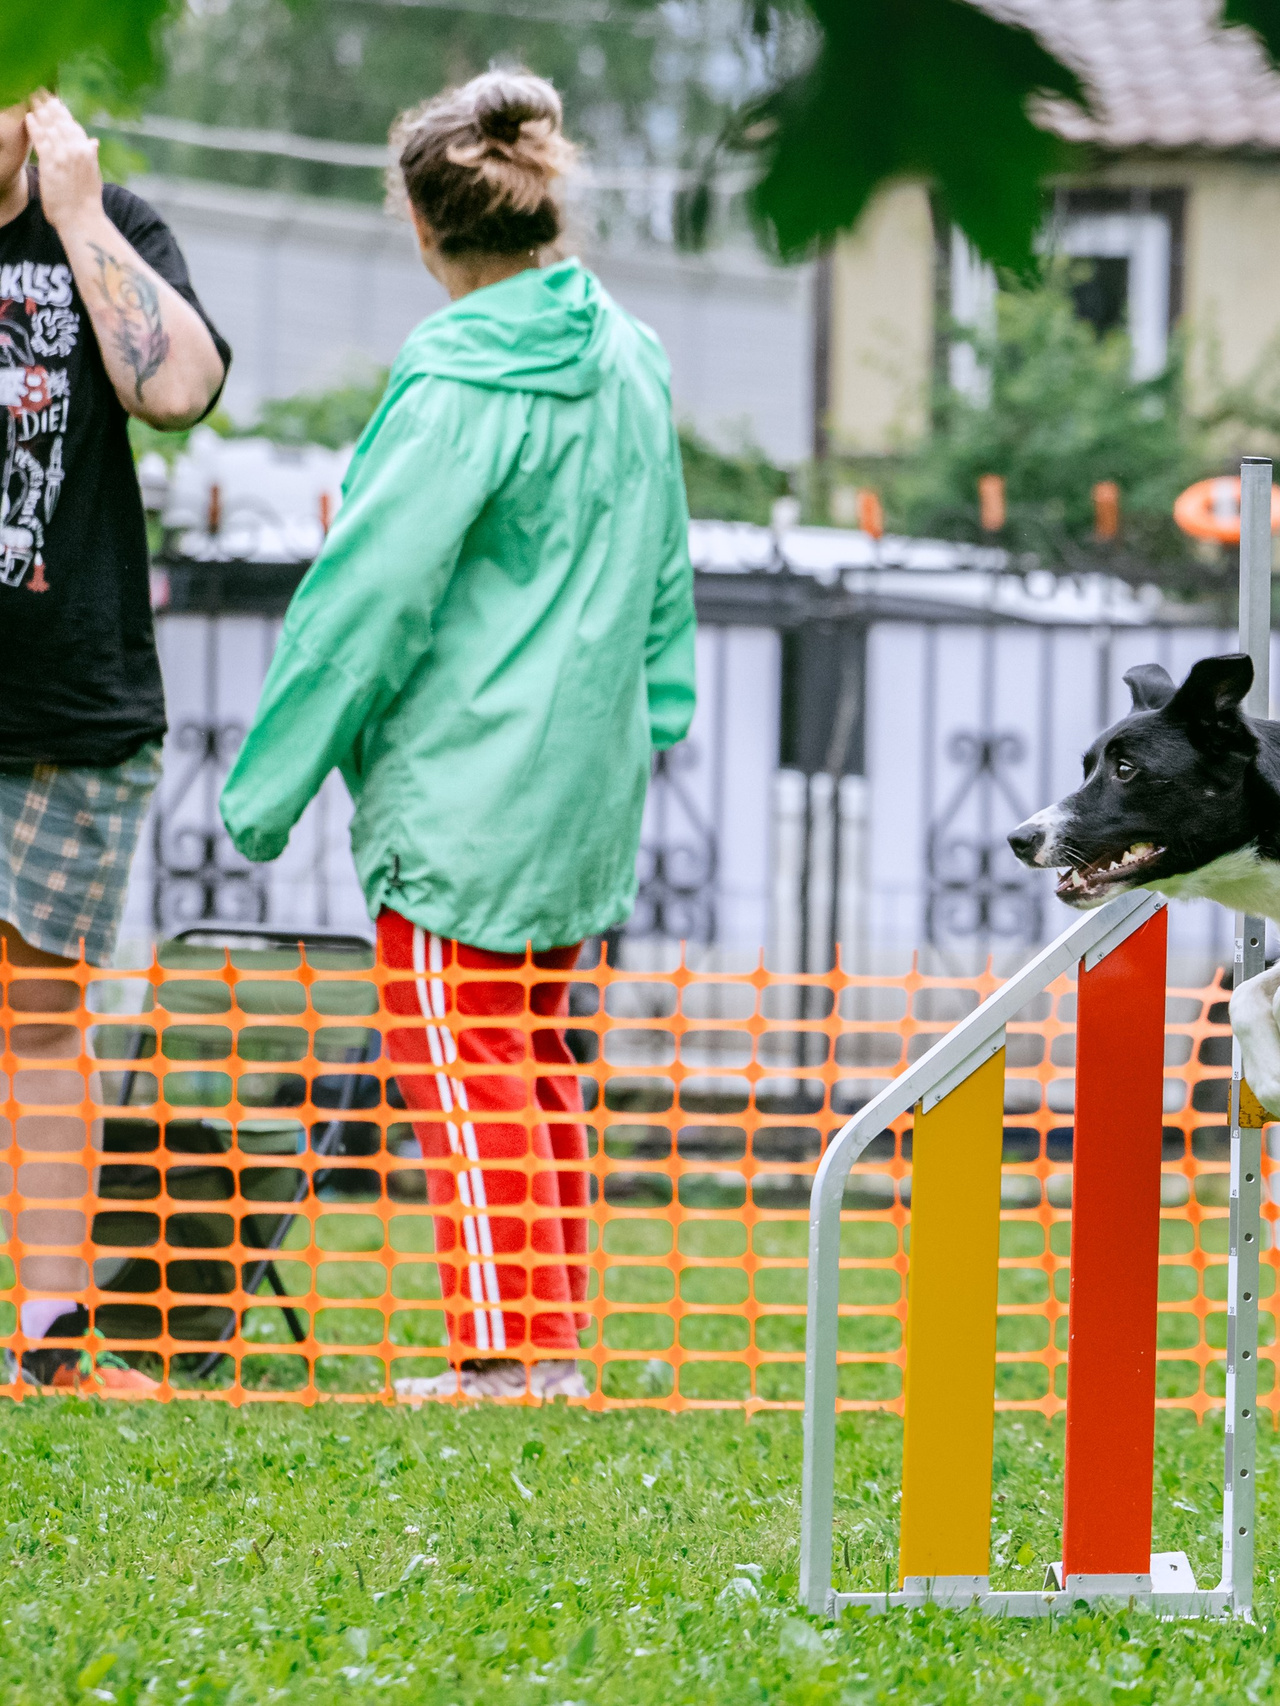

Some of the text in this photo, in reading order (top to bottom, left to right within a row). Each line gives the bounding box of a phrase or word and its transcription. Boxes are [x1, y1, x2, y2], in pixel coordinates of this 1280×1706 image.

[0, 260, 73, 307] KLES
[18, 397, 69, 442] DIE!
[1232, 1129, 1239, 1138] 45
